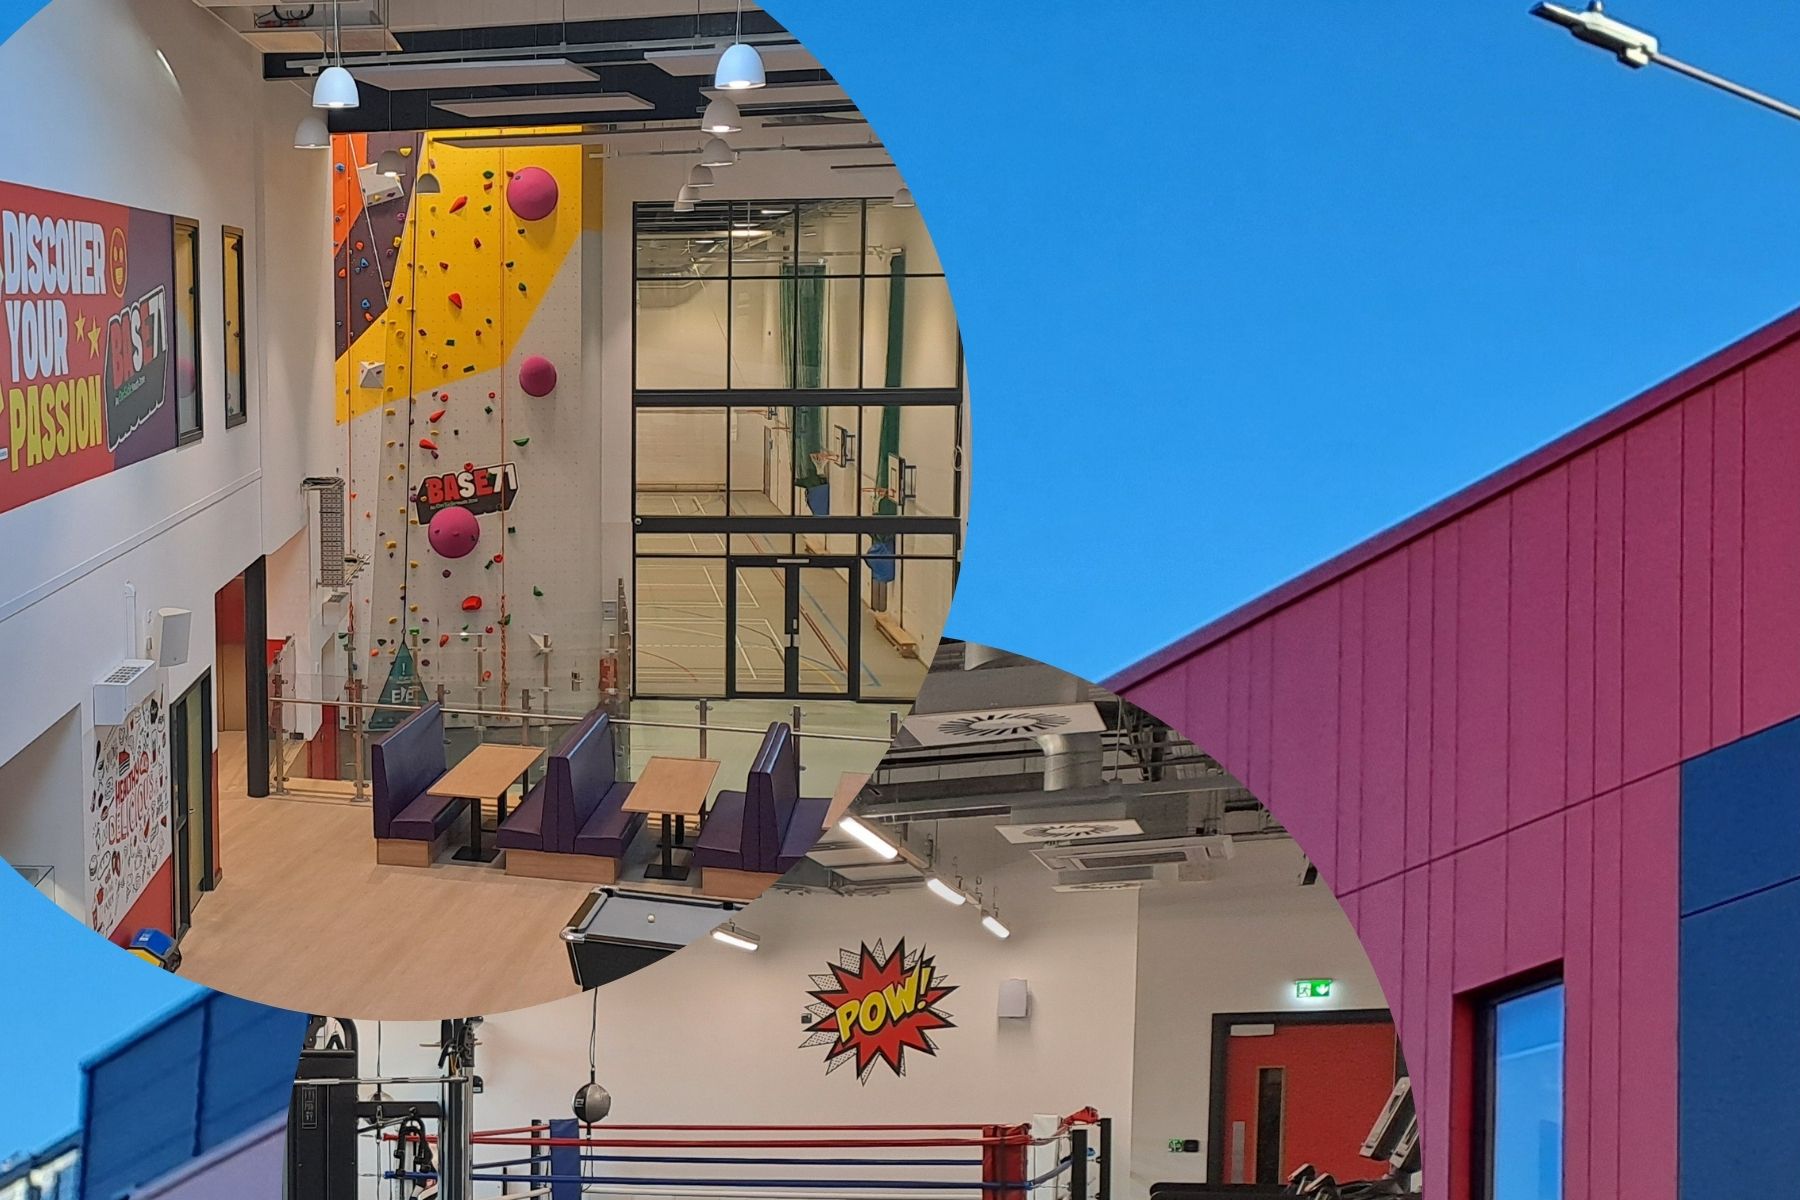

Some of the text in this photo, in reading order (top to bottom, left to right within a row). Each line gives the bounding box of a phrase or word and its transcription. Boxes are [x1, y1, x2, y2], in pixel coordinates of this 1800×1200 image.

[2, 210, 107, 295] DISCOVER
[6, 300, 69, 382] YOUR
[111, 292, 166, 390] BASE71
[9, 374, 103, 471] PASSION
[426, 464, 517, 504] BASE71
[835, 957, 932, 1043] POW!
